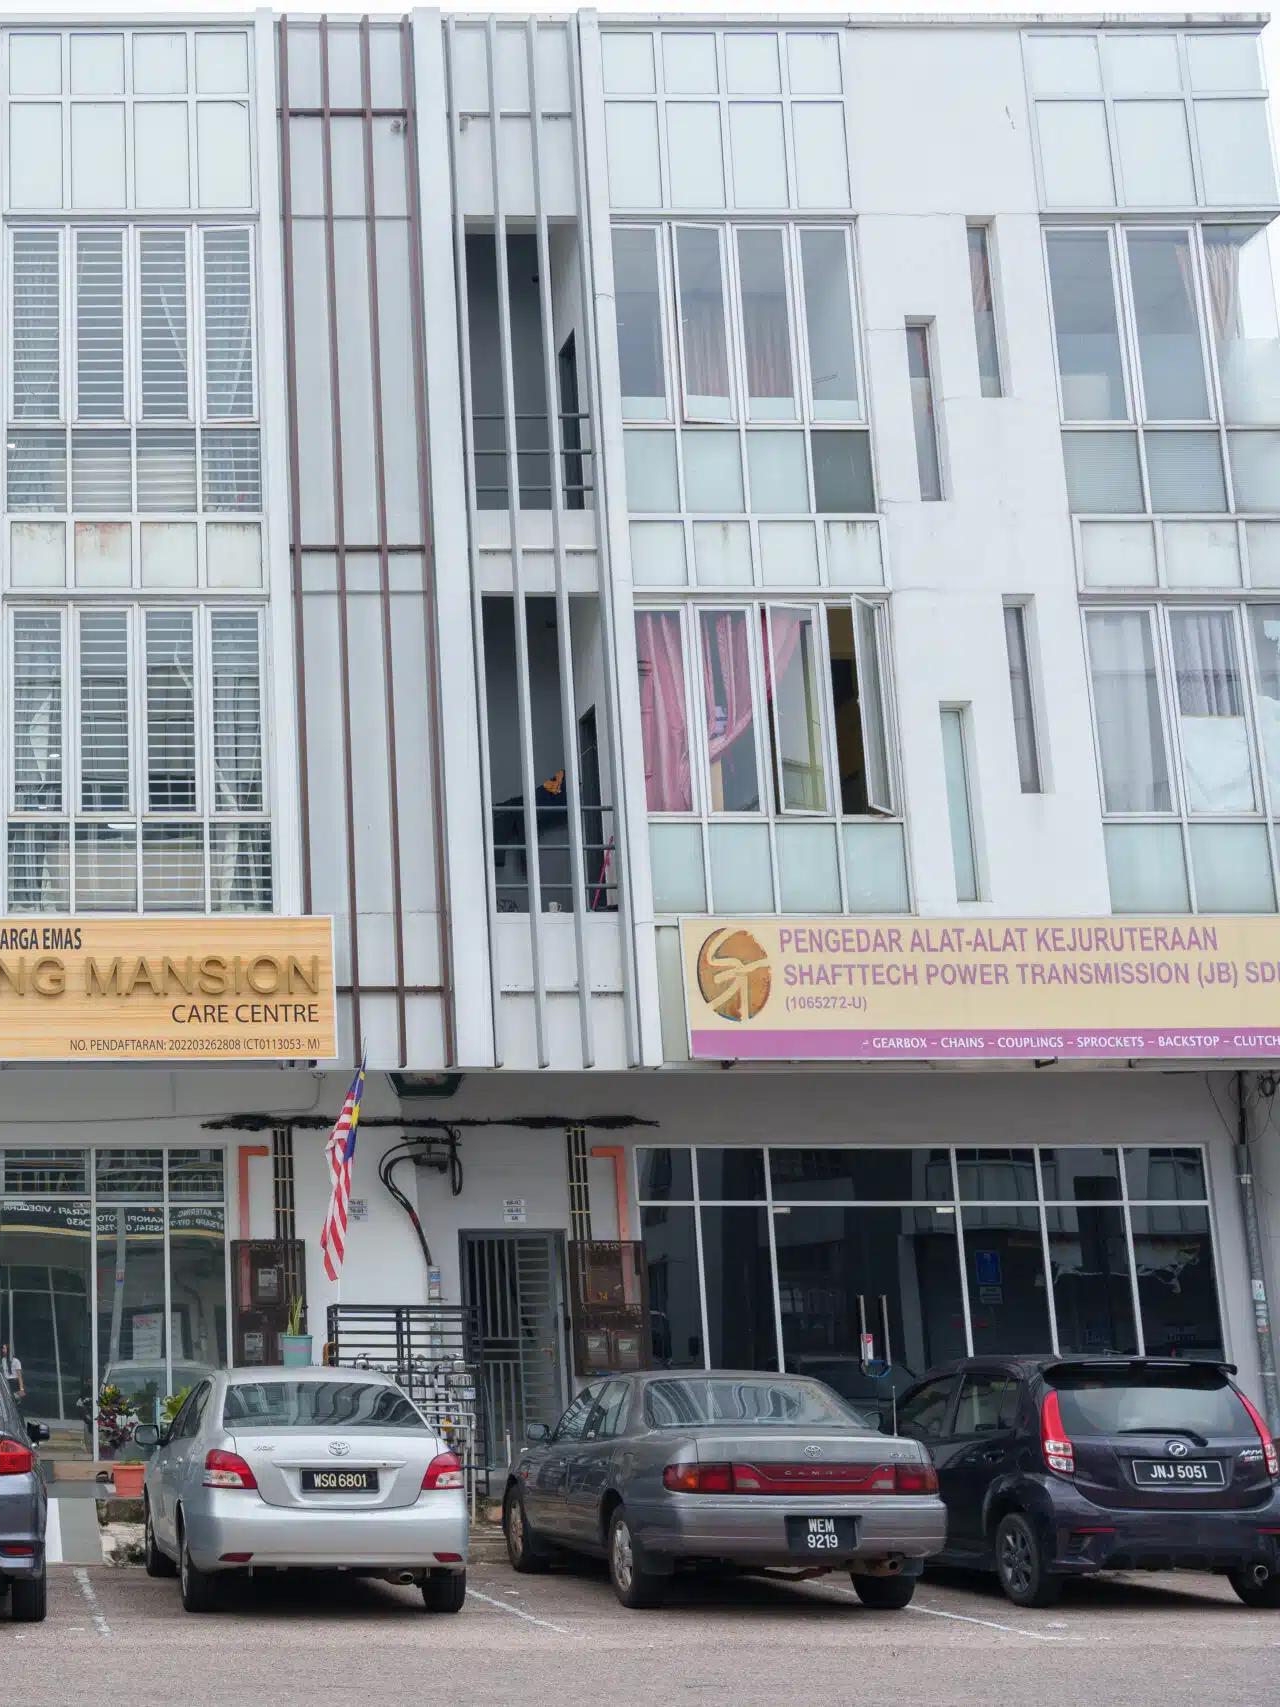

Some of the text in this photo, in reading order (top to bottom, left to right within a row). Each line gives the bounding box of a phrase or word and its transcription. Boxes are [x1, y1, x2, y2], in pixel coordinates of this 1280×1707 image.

[42, 927, 82, 950] EMAS
[779, 926, 1220, 954] PENGEDAR ALAT-ALAT KEJURUTERAAN
[84, 954, 320, 996] MANSION
[783, 960, 1280, 989] SHAFTTECH POWER TRANSMISSION (JB) SD
[785, 995, 868, 1013] (1065272-U)
[171, 1003, 320, 1024] CARE CENTRE
[70, 1039, 88, 1051] NO.
[90, 1039, 167, 1051] PENDAFTARAN:
[169, 1038, 241, 1051] 202203262808
[872, 1037, 927, 1049] GEARBOX
[940, 1037, 985, 1049] CHAINS
[997, 1036, 1064, 1048] COUPLINGS
[1076, 1036, 1145, 1048] SPROCKETS
[1158, 1035, 1220, 1047] BACKSTOP
[1150, 1465, 1208, 1479] JNJ 5051
[313, 1473, 367, 1488] WSQ 6801
[807, 1518, 835, 1533] WEM
[806, 1534, 839, 1549] 9219
